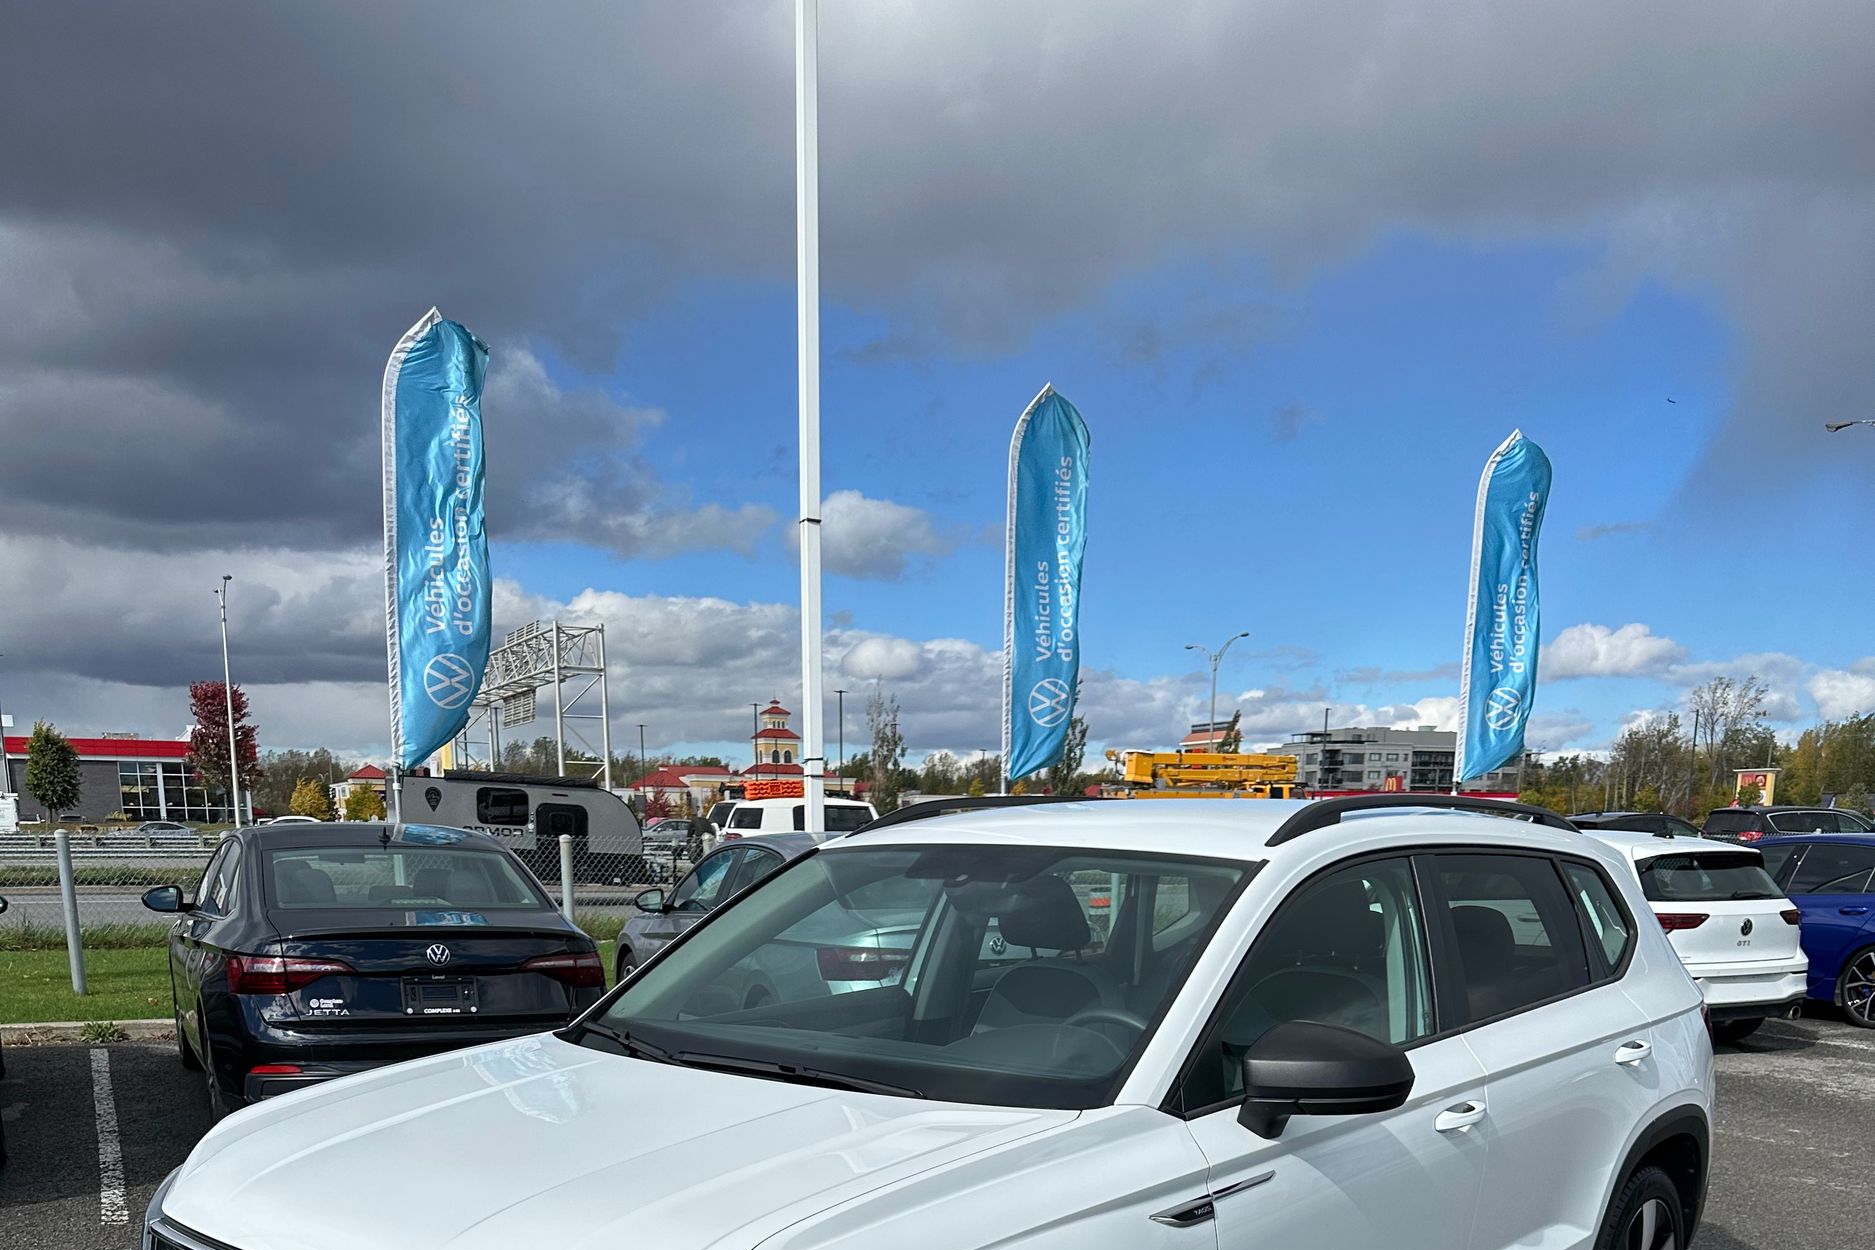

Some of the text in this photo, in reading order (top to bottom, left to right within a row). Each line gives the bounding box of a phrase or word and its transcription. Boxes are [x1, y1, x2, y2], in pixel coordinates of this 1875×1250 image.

[425, 518, 446, 635] Véhicules
[453, 507, 473, 636] d'occasion
[1035, 561, 1051, 662] Véhicules
[1054, 456, 1073, 662] d'occasion certifiés
[1508, 491, 1539, 673] d'occasion certifiés
[1490, 583, 1508, 674] Véhicules
